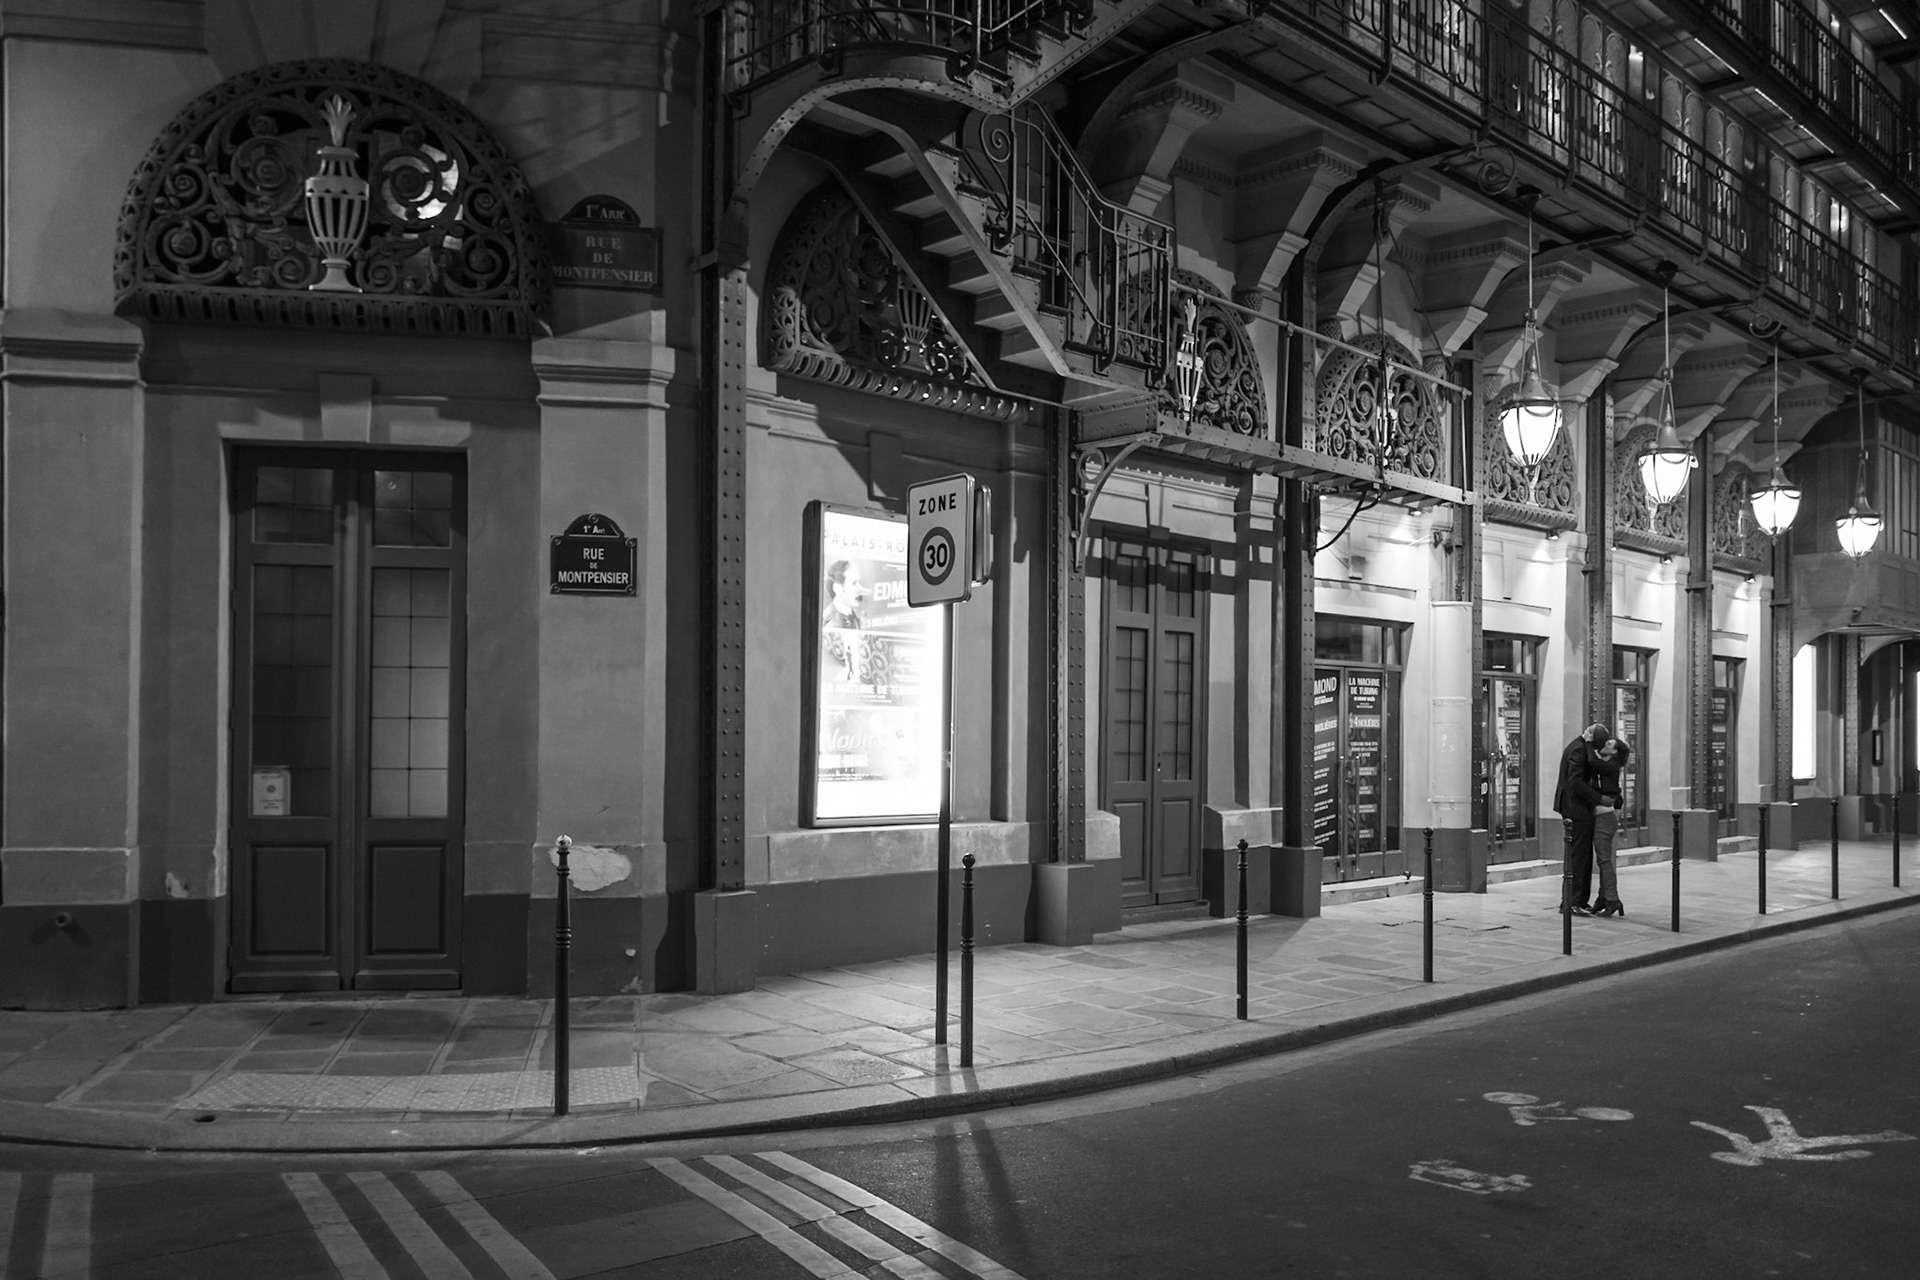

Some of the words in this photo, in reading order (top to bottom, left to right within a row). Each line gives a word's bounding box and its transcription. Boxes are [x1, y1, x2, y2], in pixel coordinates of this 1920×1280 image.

[585, 236, 621, 250] RUE
[593, 252, 613, 264] DE
[552, 264, 654, 283] MONTPENSIER
[918, 492, 957, 516] ZONE
[583, 547, 605, 560] RUE
[925, 543, 948, 570] 30
[558, 571, 629, 584] MONTPENSIER
[1349, 677, 1356, 686] LA
[1357, 678, 1380, 686] MACHINE
[1350, 687, 1358, 695] DE
[1315, 719, 1337, 732] MOLIÈRES
